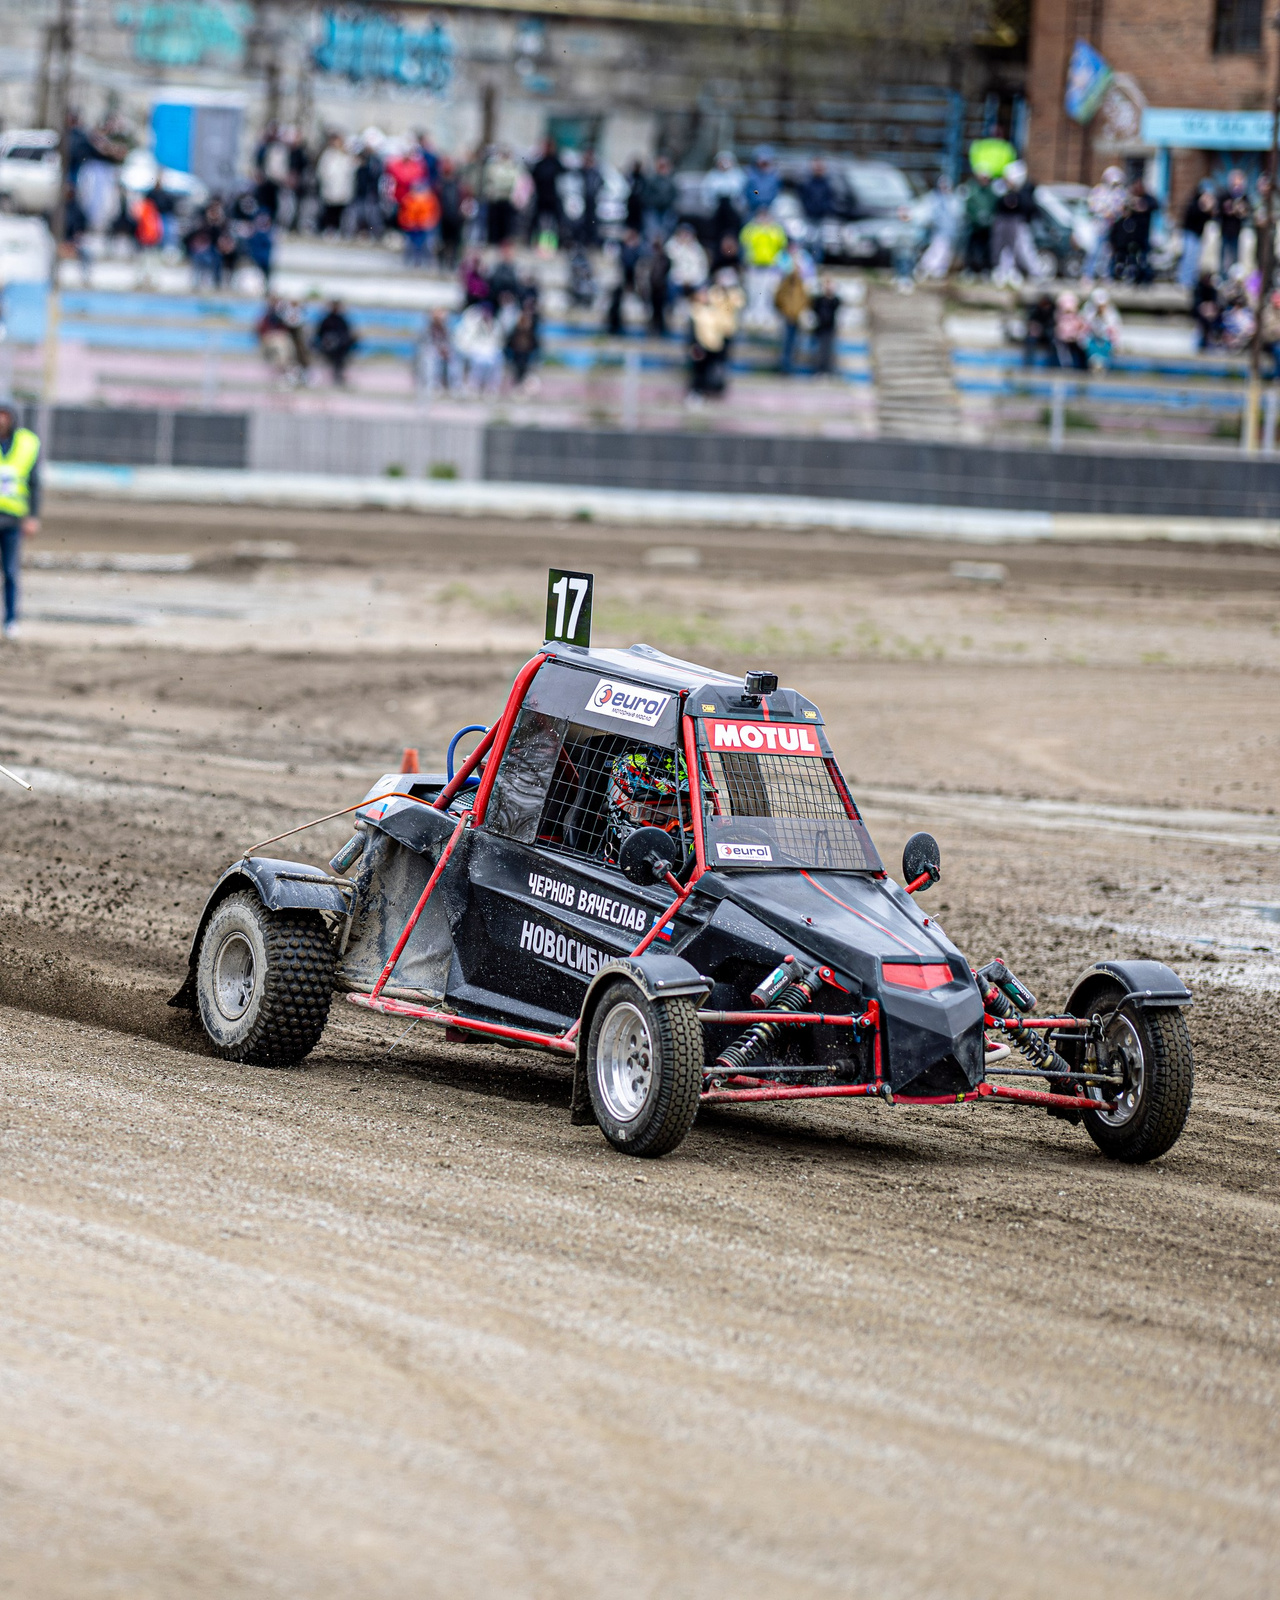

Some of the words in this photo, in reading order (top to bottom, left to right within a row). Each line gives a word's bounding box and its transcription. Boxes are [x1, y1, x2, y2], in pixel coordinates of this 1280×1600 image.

[552, 576, 589, 640] 17
[611, 692, 667, 716] eurol
[714, 723, 816, 752] MOTUL
[733, 846, 768, 856] eurol
[528, 872, 576, 907] ЧЕРНОВ
[577, 889, 647, 932] ВЯЧЕСЛАВ
